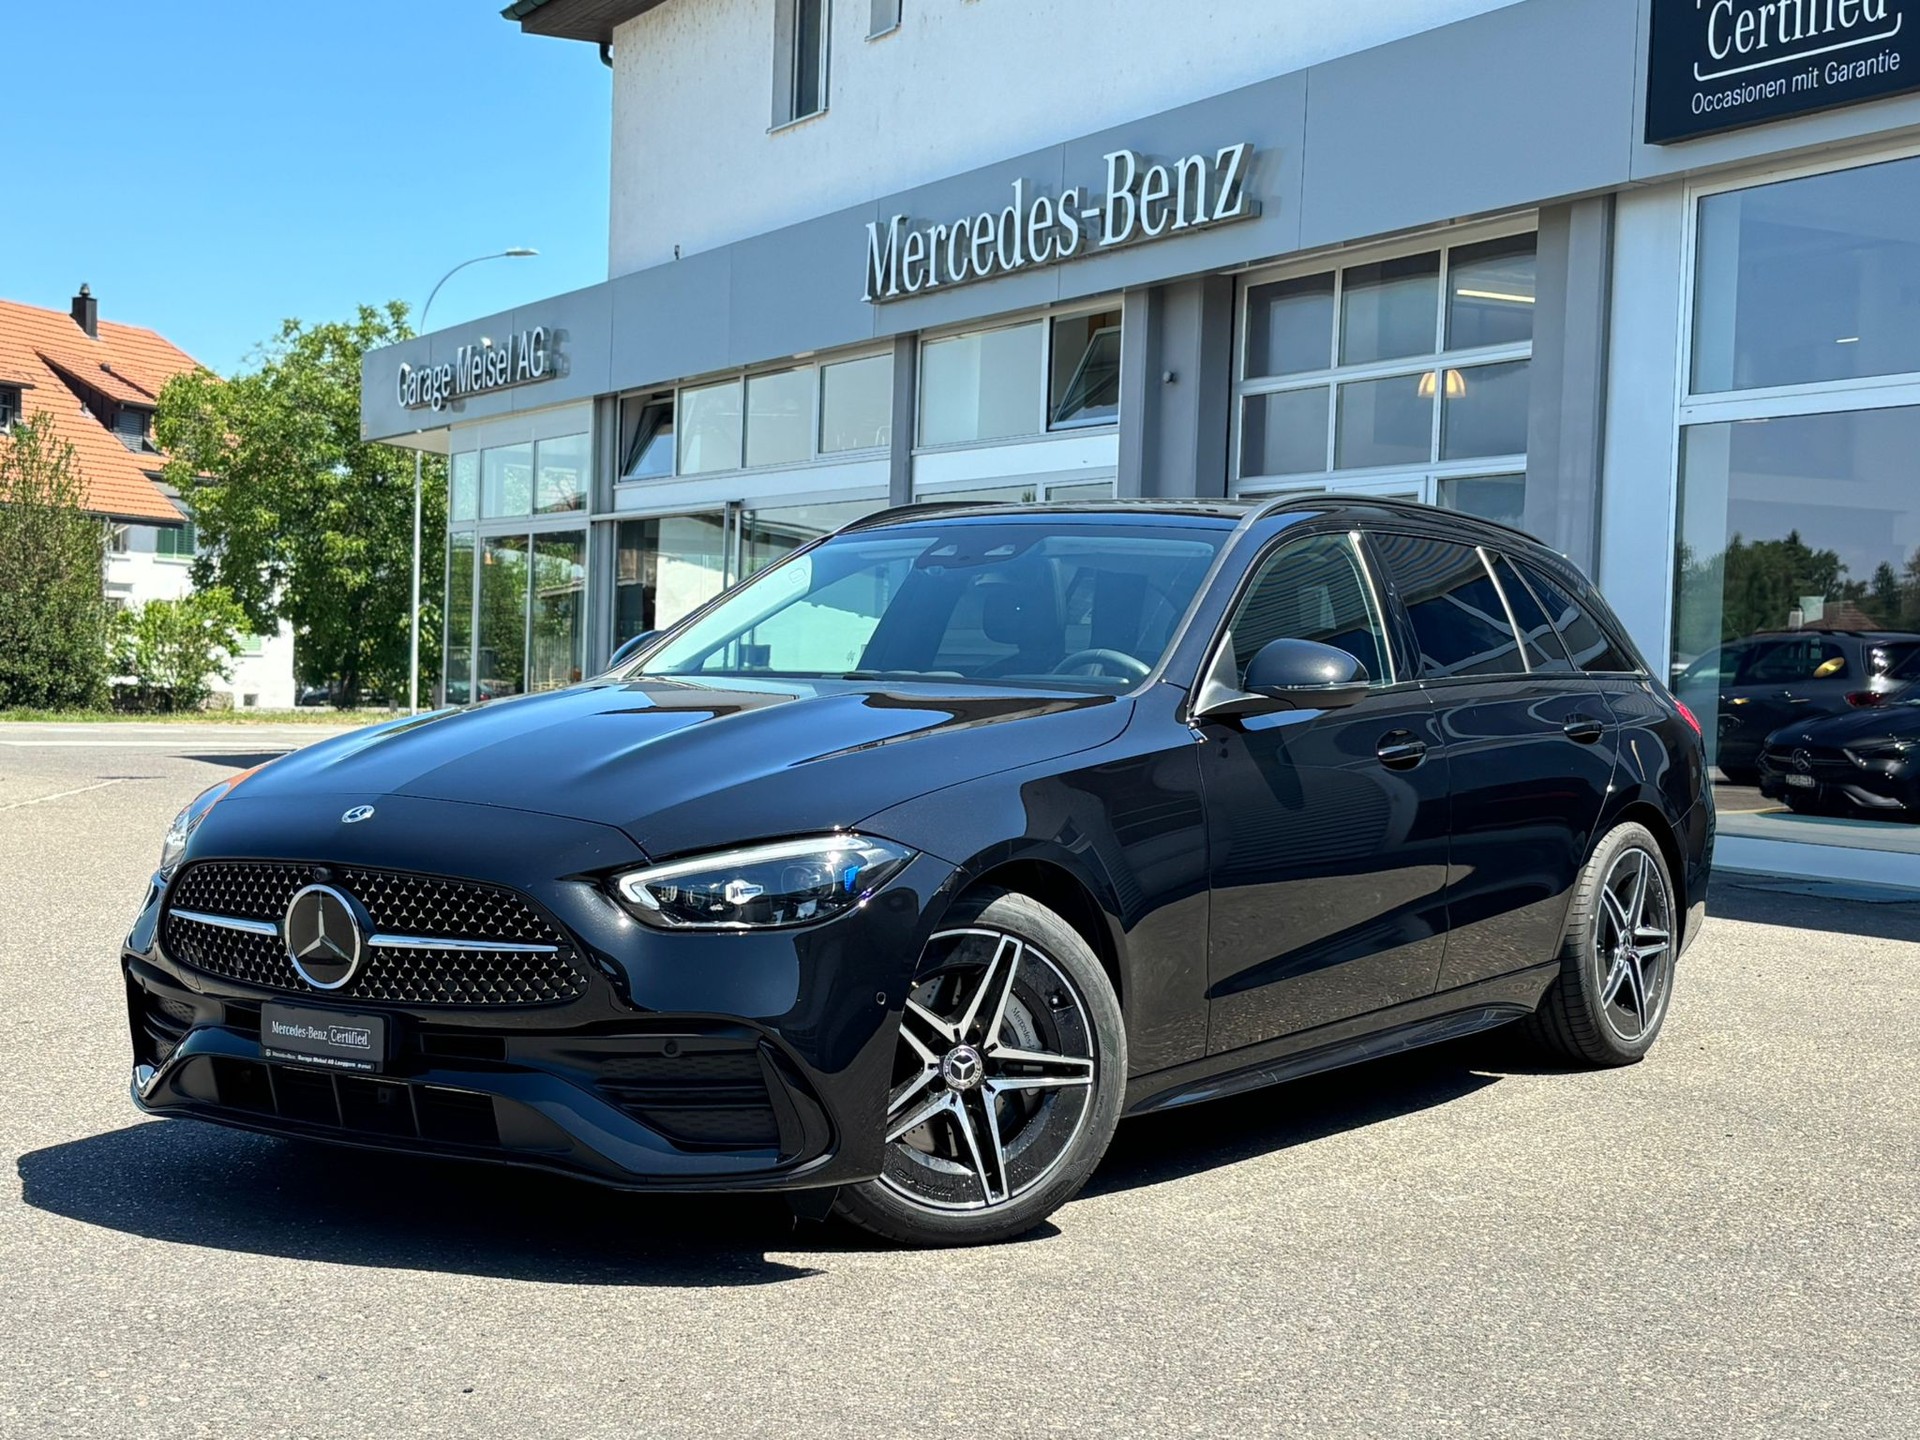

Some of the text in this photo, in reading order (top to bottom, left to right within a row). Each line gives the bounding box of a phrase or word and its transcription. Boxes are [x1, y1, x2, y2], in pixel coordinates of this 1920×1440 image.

[1691, 49, 1901, 115] Occasionen mit Garantie
[861, 142, 1248, 303] Mercedes-Benz
[397, 326, 545, 411] Garage Meisel AG
[272, 1021, 368, 1046] Mercedes-Benz Certified
